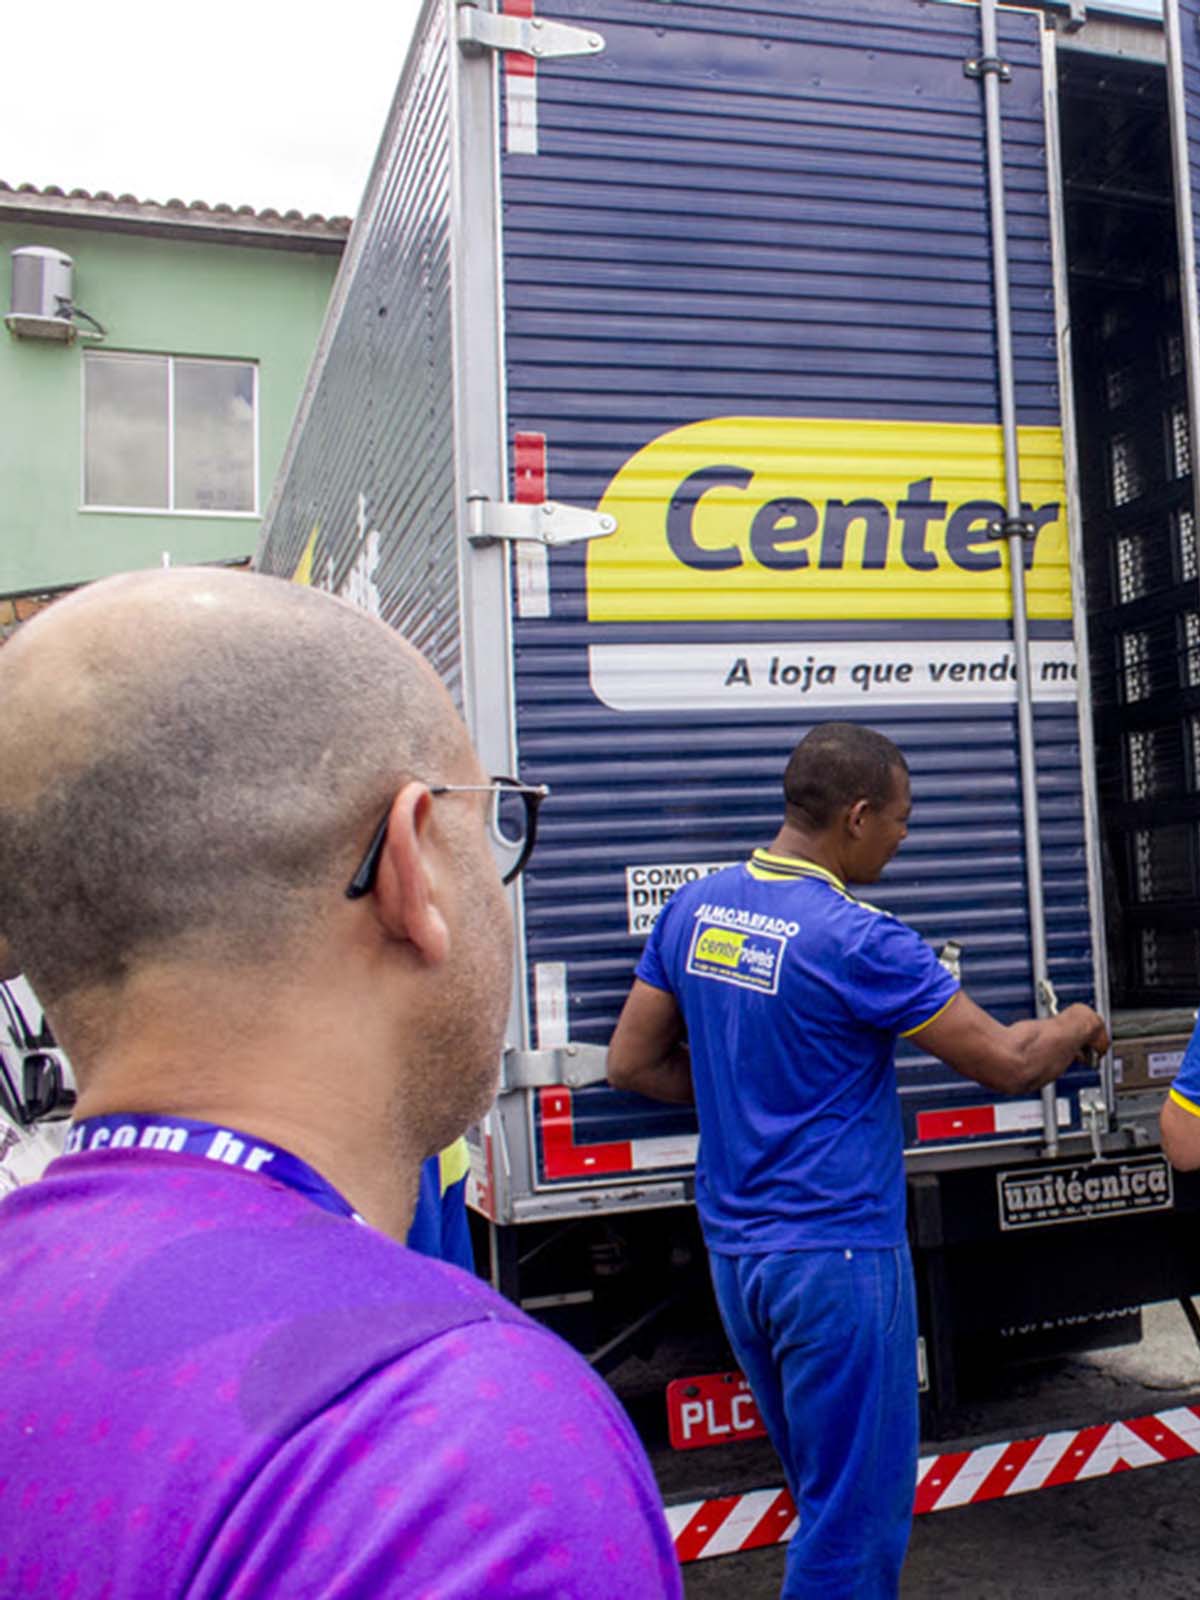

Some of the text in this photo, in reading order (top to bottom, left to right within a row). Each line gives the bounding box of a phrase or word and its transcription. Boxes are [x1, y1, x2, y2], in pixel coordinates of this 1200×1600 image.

[665, 465, 1061, 572] Center
[725, 658, 752, 686] A
[768, 657, 836, 691] loja
[851, 661, 913, 691] que
[632, 867, 699, 886] COMO
[1005, 1163, 1167, 1211] unitécnica
[681, 1394, 755, 1440] PLC
